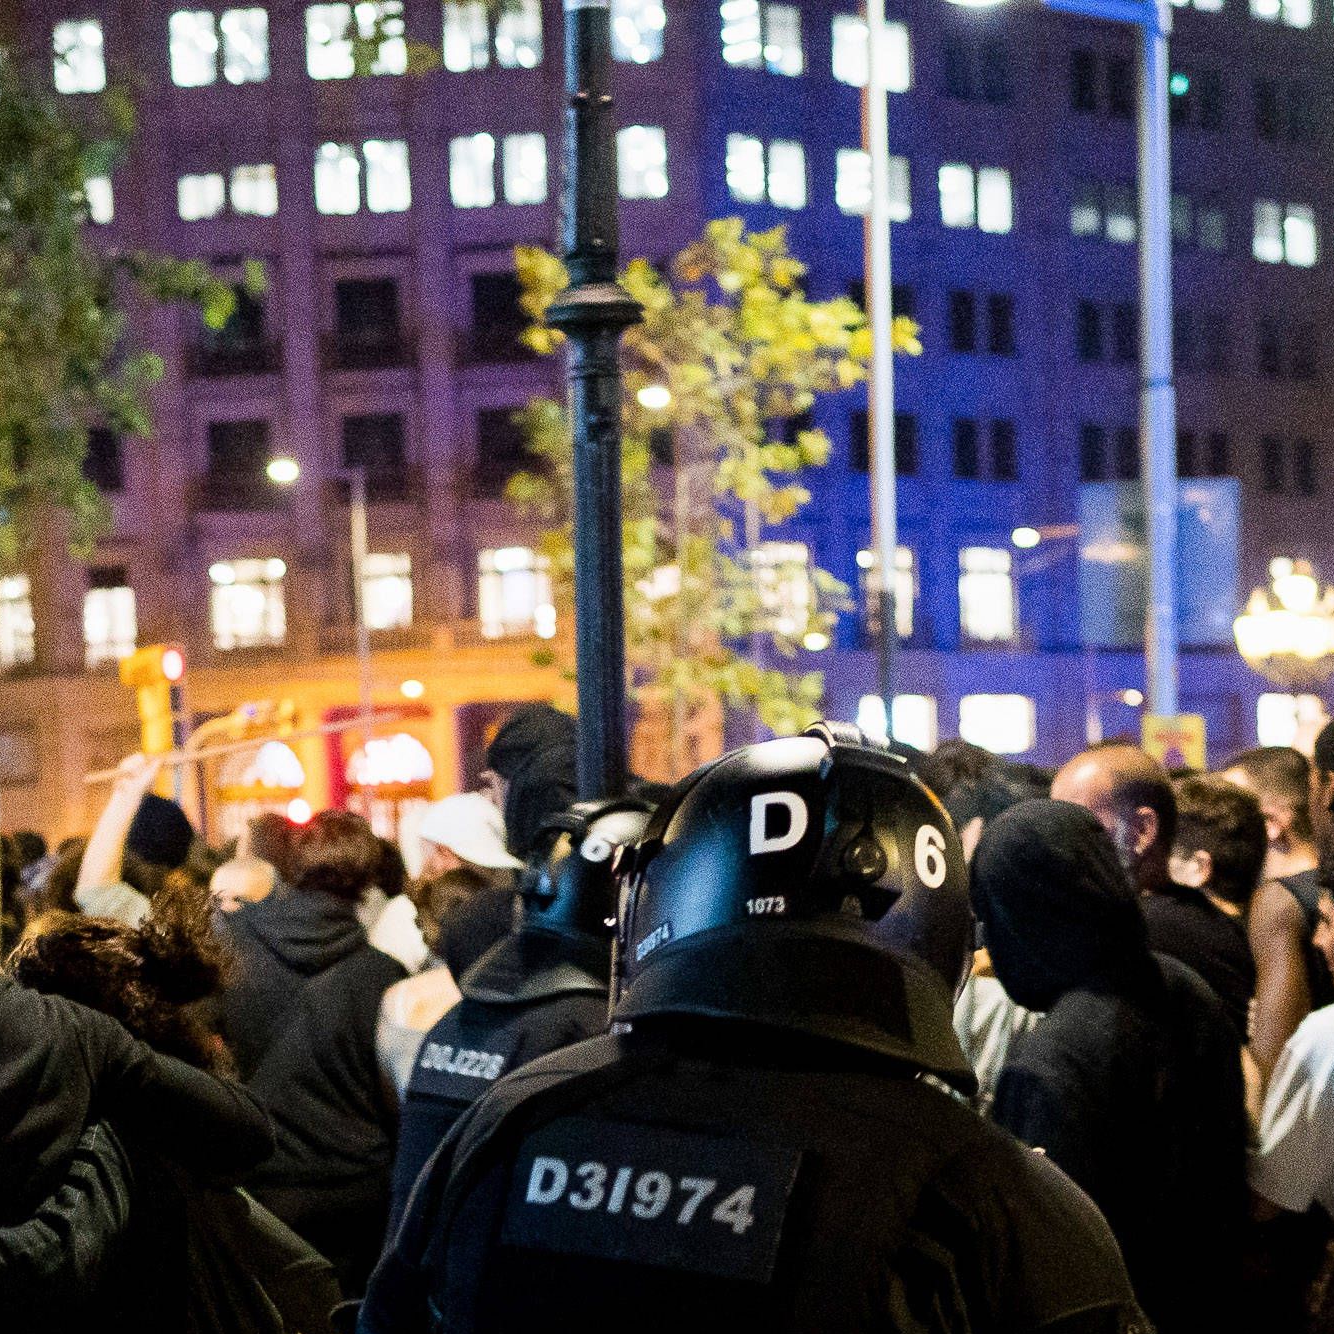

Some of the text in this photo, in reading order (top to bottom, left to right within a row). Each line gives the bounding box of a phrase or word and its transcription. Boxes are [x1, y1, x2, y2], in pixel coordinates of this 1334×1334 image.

[579, 831, 616, 863] 6
[749, 790, 809, 856] D
[914, 824, 947, 889] 6
[746, 895, 786, 915] 1073
